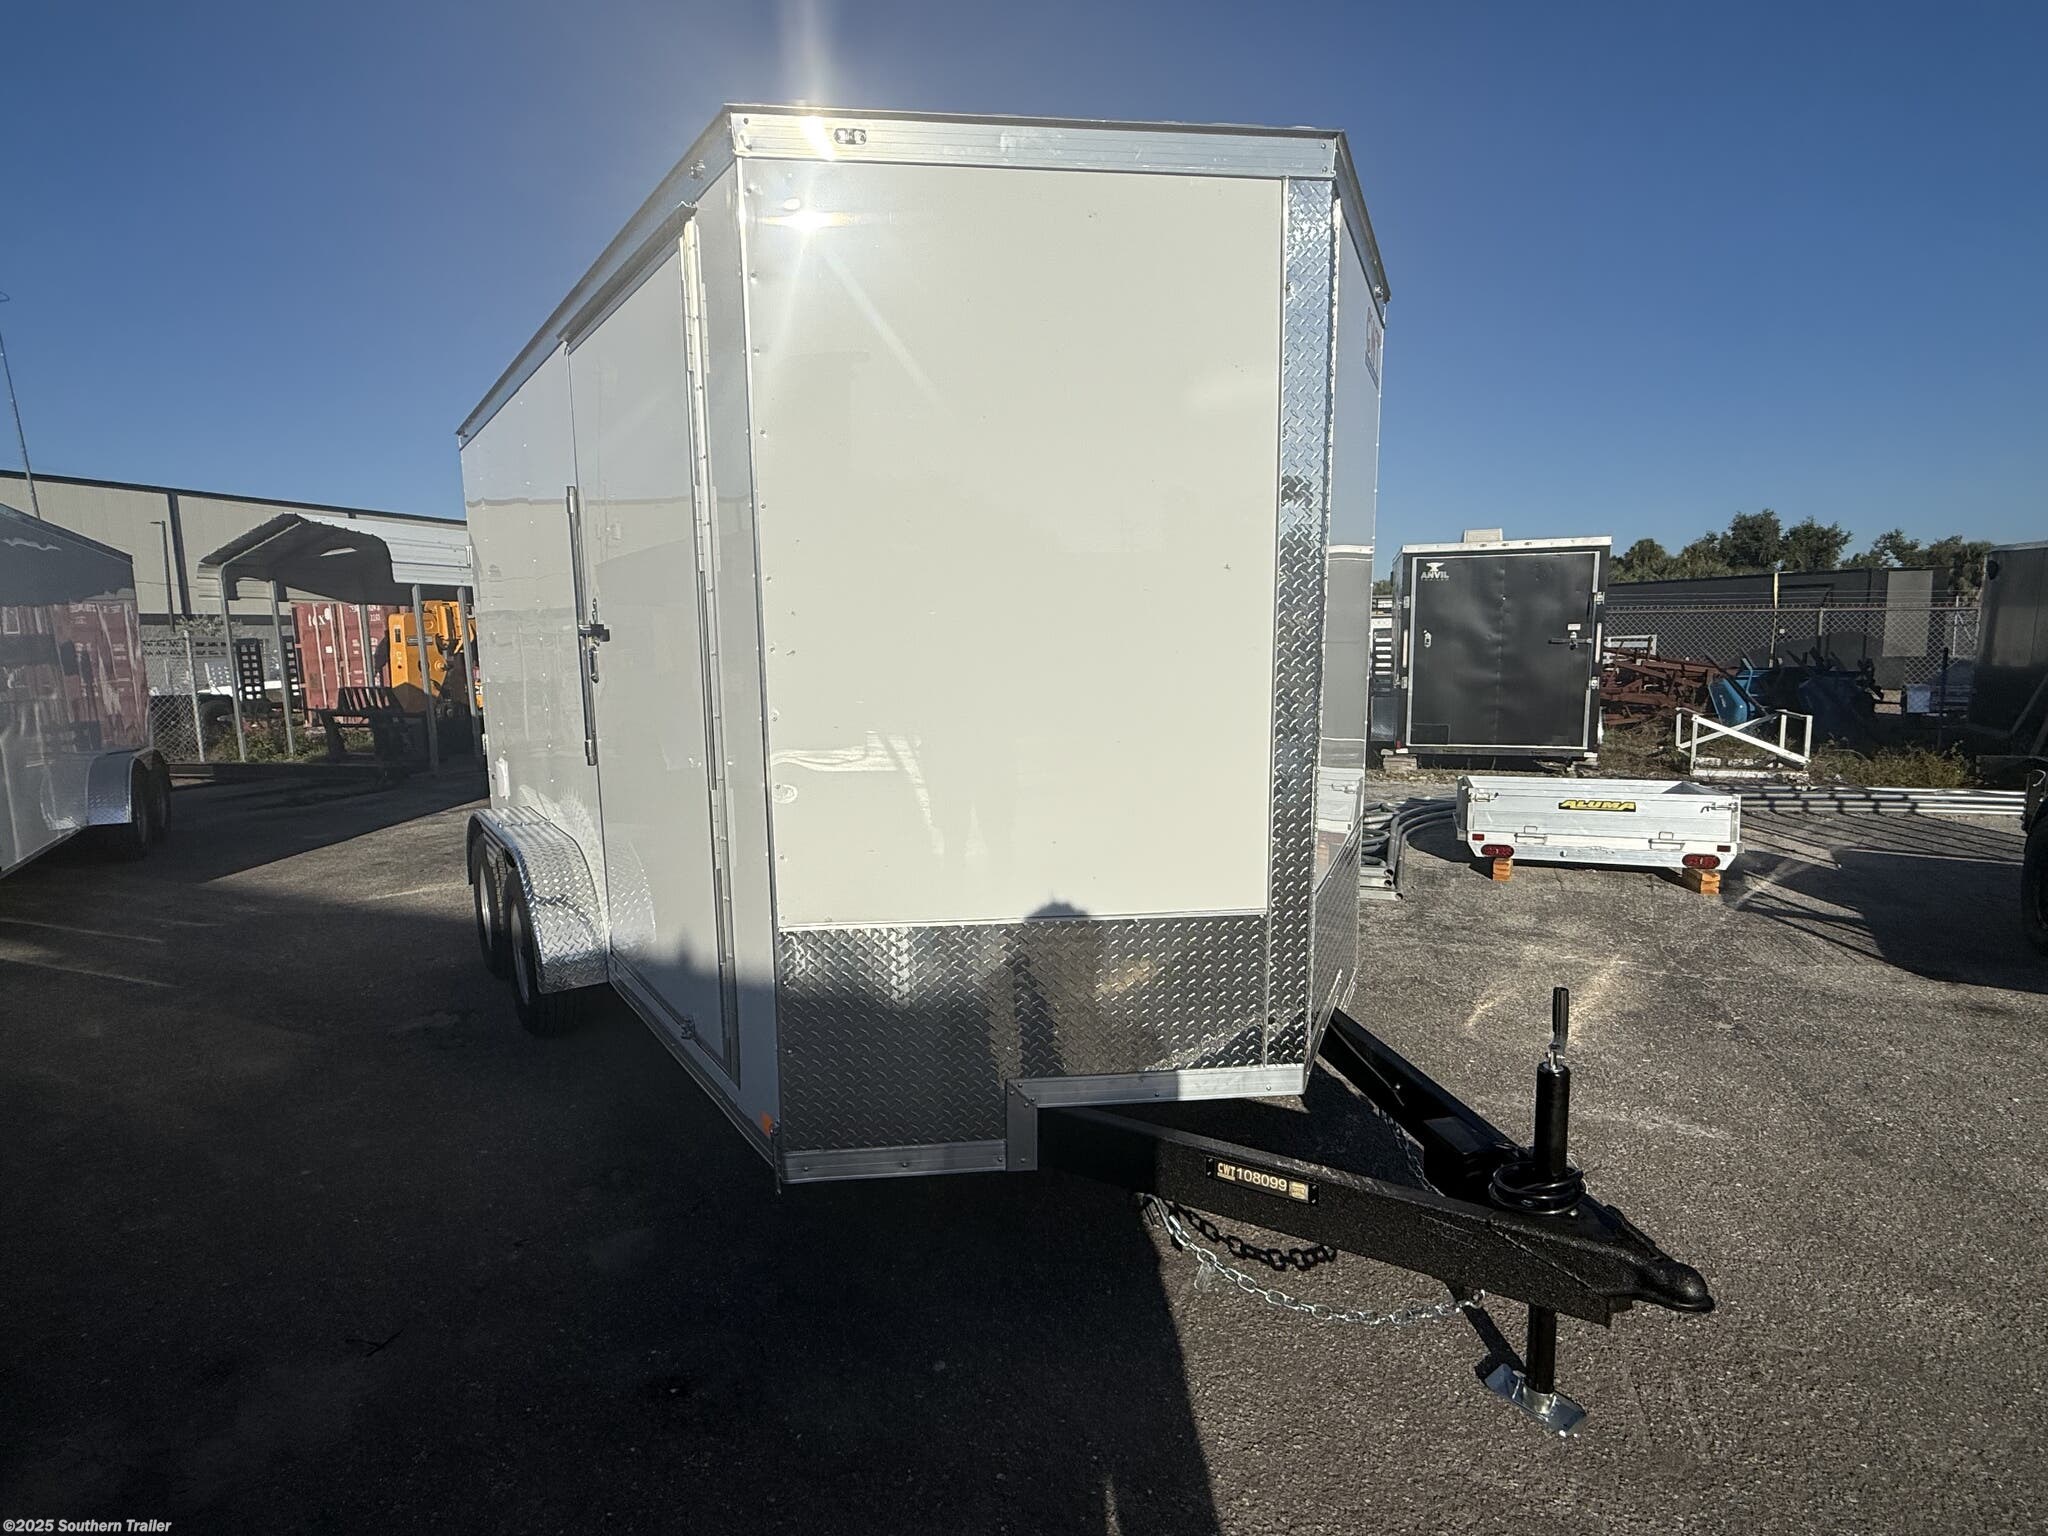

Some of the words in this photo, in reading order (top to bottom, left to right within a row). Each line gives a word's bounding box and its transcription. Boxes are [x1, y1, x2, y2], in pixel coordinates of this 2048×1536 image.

[1421, 571, 1450, 579] ANVIL
[1560, 799, 1635, 811] ALUMA
[1217, 1162, 1236, 1177] CWT
[1236, 1167, 1288, 1192] 108099
